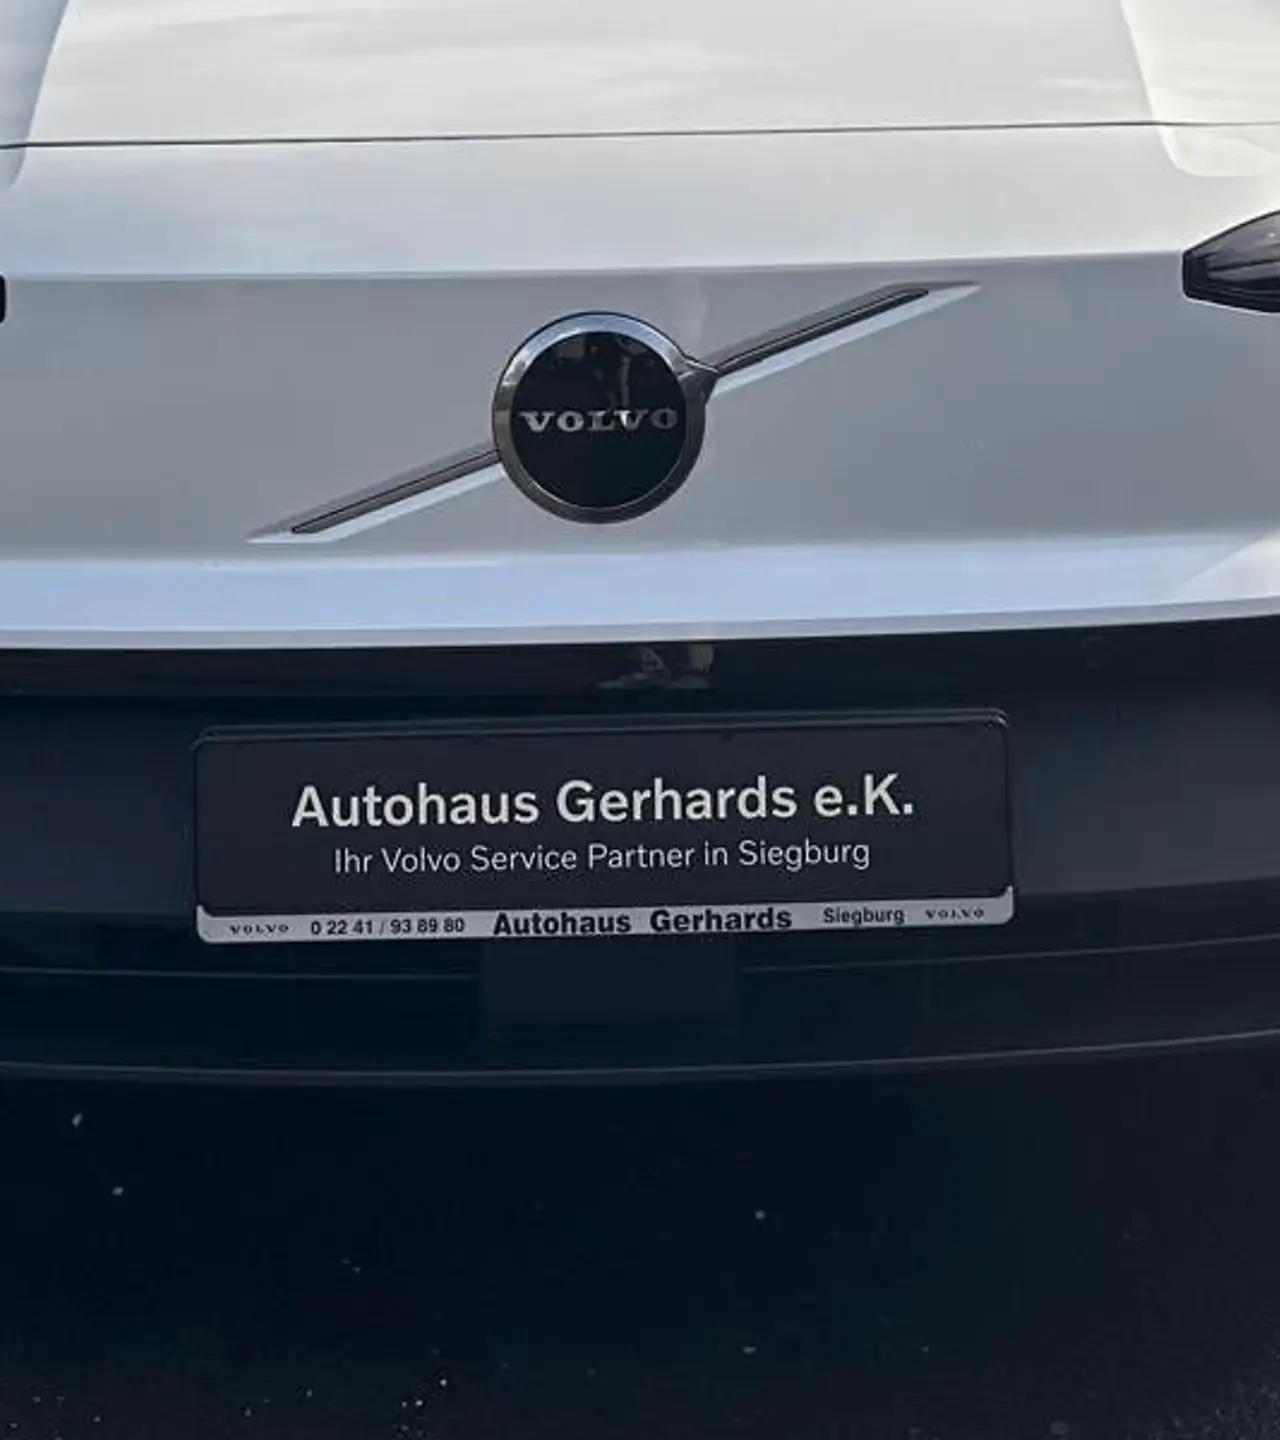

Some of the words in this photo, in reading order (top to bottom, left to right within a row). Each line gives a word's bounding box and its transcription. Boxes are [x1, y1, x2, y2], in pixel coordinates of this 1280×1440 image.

[521, 408, 678, 434] VOLVO
[291, 782, 540, 828] Autohaus
[556, 774, 798, 824] Gerhards
[813, 772, 914, 817] e.K.
[333, 847, 373, 873] Ihr
[380, 846, 462, 873] Volvo
[470, 843, 578, 872] Service
[588, 841, 696, 870] Partner
[703, 840, 729, 866] in
[737, 837, 871, 871] Siegburg
[229, 924, 291, 936] VOLVO
[493, 910, 632, 935] Autohaus
[650, 906, 793, 933] Gerhards
[822, 906, 905, 927] Siegburg
[924, 908, 986, 921] VOLVO
